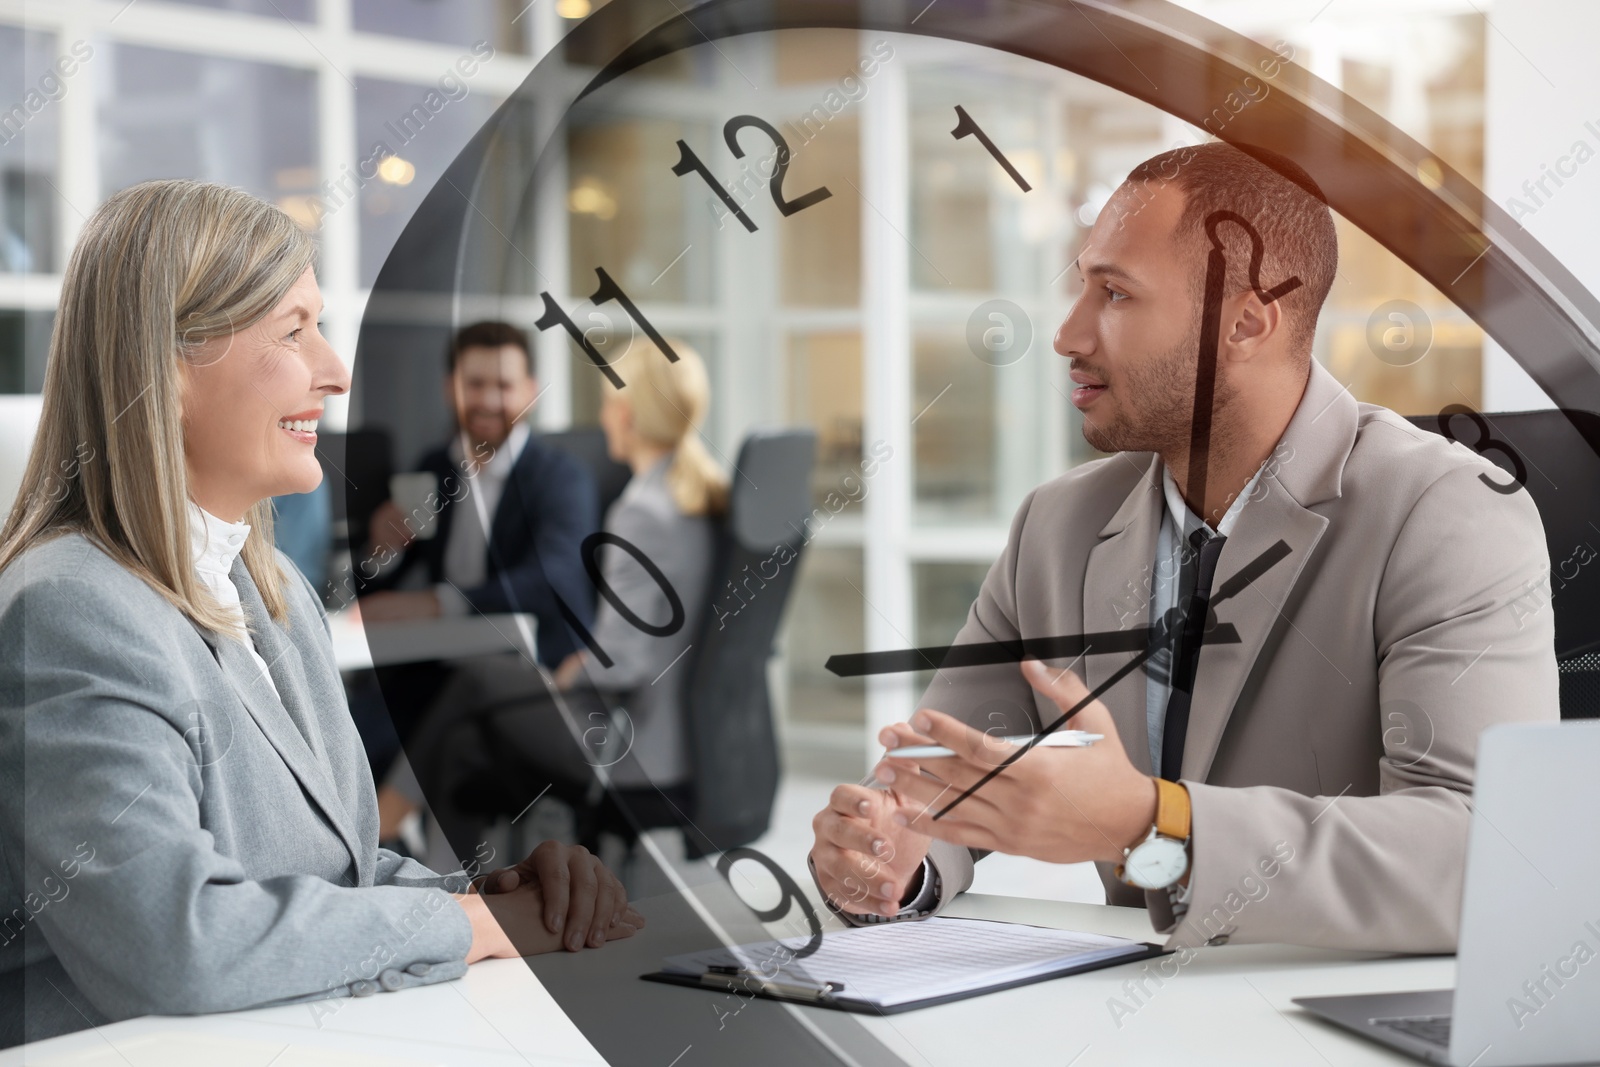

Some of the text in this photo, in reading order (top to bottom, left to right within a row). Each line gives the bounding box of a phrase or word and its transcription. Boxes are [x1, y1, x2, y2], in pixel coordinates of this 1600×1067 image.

[671, 114, 833, 234] 12
[950, 104, 1033, 194] 1
[1204, 210, 1304, 306] 2
[534, 266, 681, 391] 11
[1437, 403, 1528, 496] 3
[715, 847, 823, 959] 9
